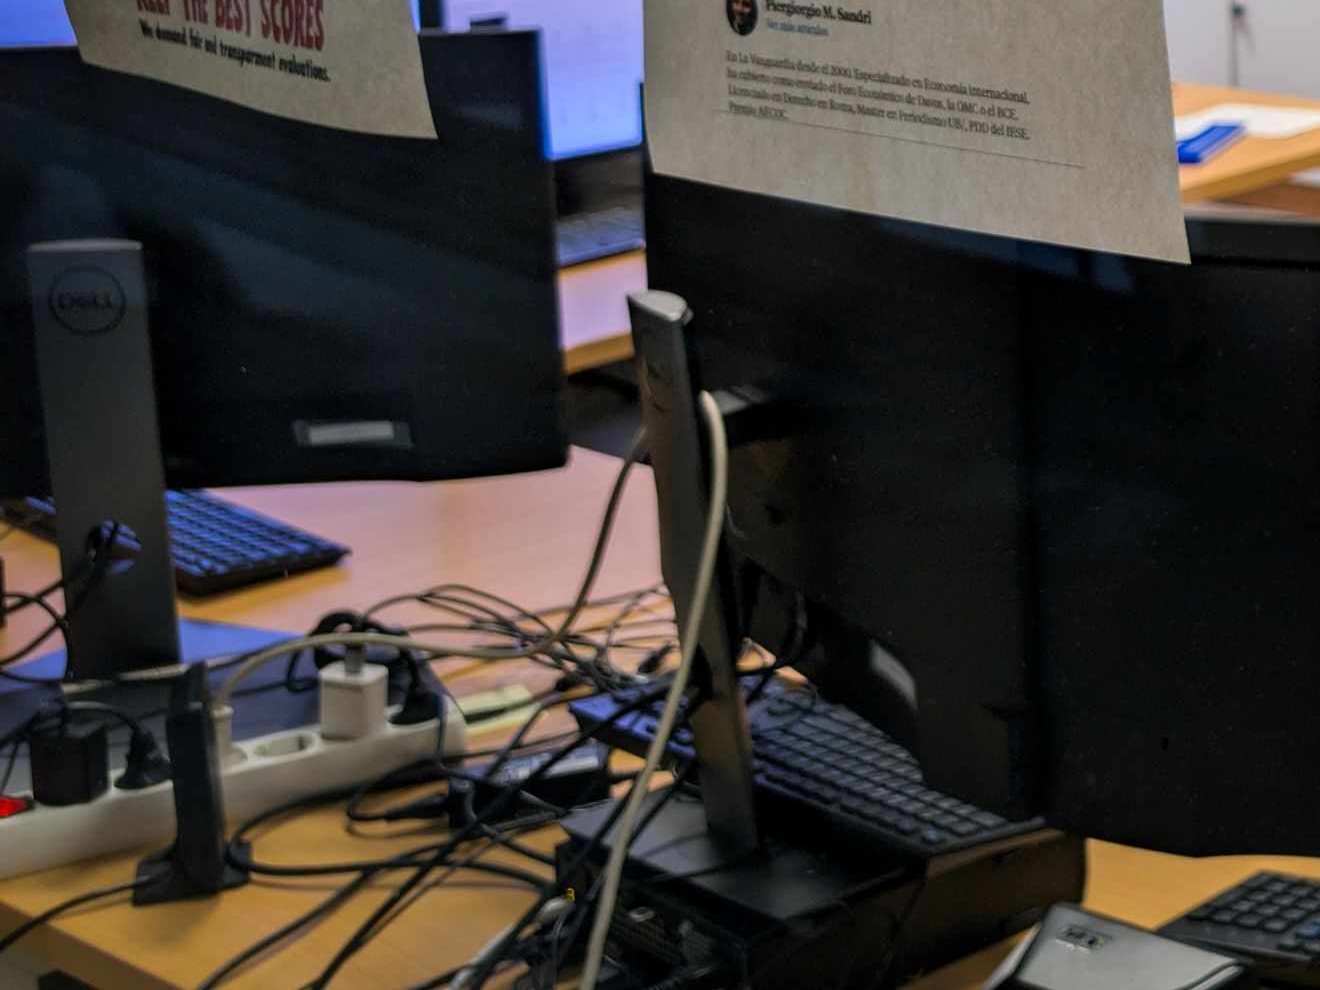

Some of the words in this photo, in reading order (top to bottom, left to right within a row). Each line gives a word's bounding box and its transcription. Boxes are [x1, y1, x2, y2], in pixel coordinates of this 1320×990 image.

[823, 6, 835, 19] M.
[838, 8, 871, 24] Sandri
[139, 18, 154, 38] We
[156, 23, 187, 44] demand
[190, 27, 203, 48] fair
[205, 40, 217, 54] and
[279, 54, 331, 82] evaluations.
